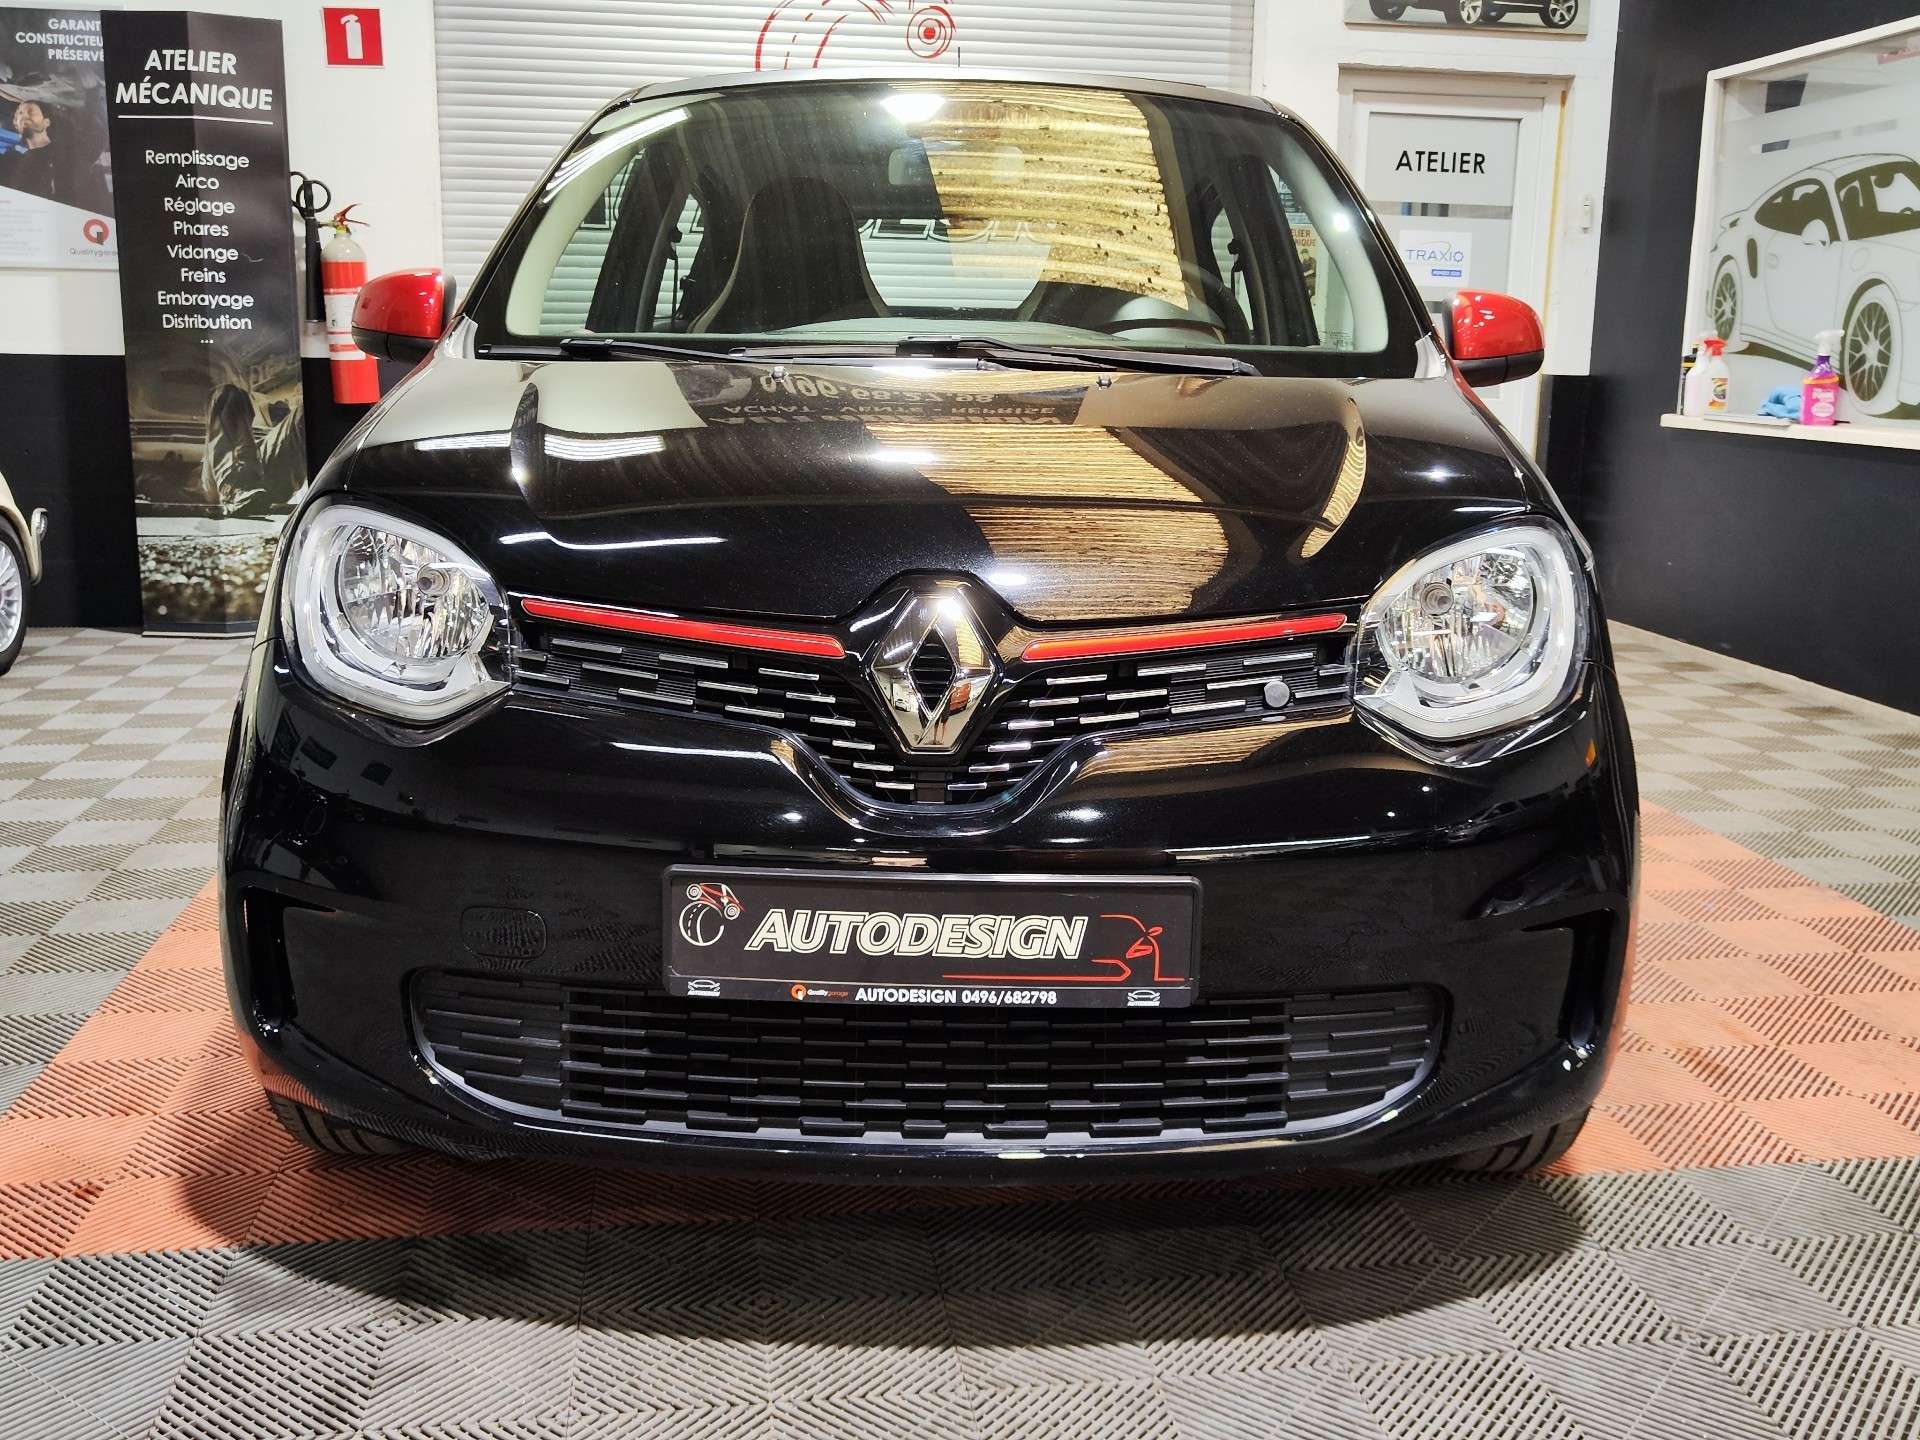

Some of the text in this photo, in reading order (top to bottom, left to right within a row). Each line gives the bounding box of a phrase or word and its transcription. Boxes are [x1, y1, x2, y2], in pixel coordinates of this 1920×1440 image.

[144, 50, 237, 75] ATELIER
[115, 76, 273, 110] MÉCANIQUE
[145, 149, 250, 170] Remplissage
[1395, 150, 1486, 174] ATELIER
[175, 173, 220, 189] Airco
[164, 197, 236, 216] Réglage
[173, 220, 230, 237] Phares
[166, 244, 239, 263] Vidange
[1406, 249, 1464, 262] TRAXIO
[180, 267, 227, 283] Freins
[157, 290, 255, 309] Embrayage
[162, 313, 253, 330] Distribution
[744, 908, 1089, 960] AUTODESIGN
[855, 987, 1057, 1004] AUTODESIGN 0496/682798
